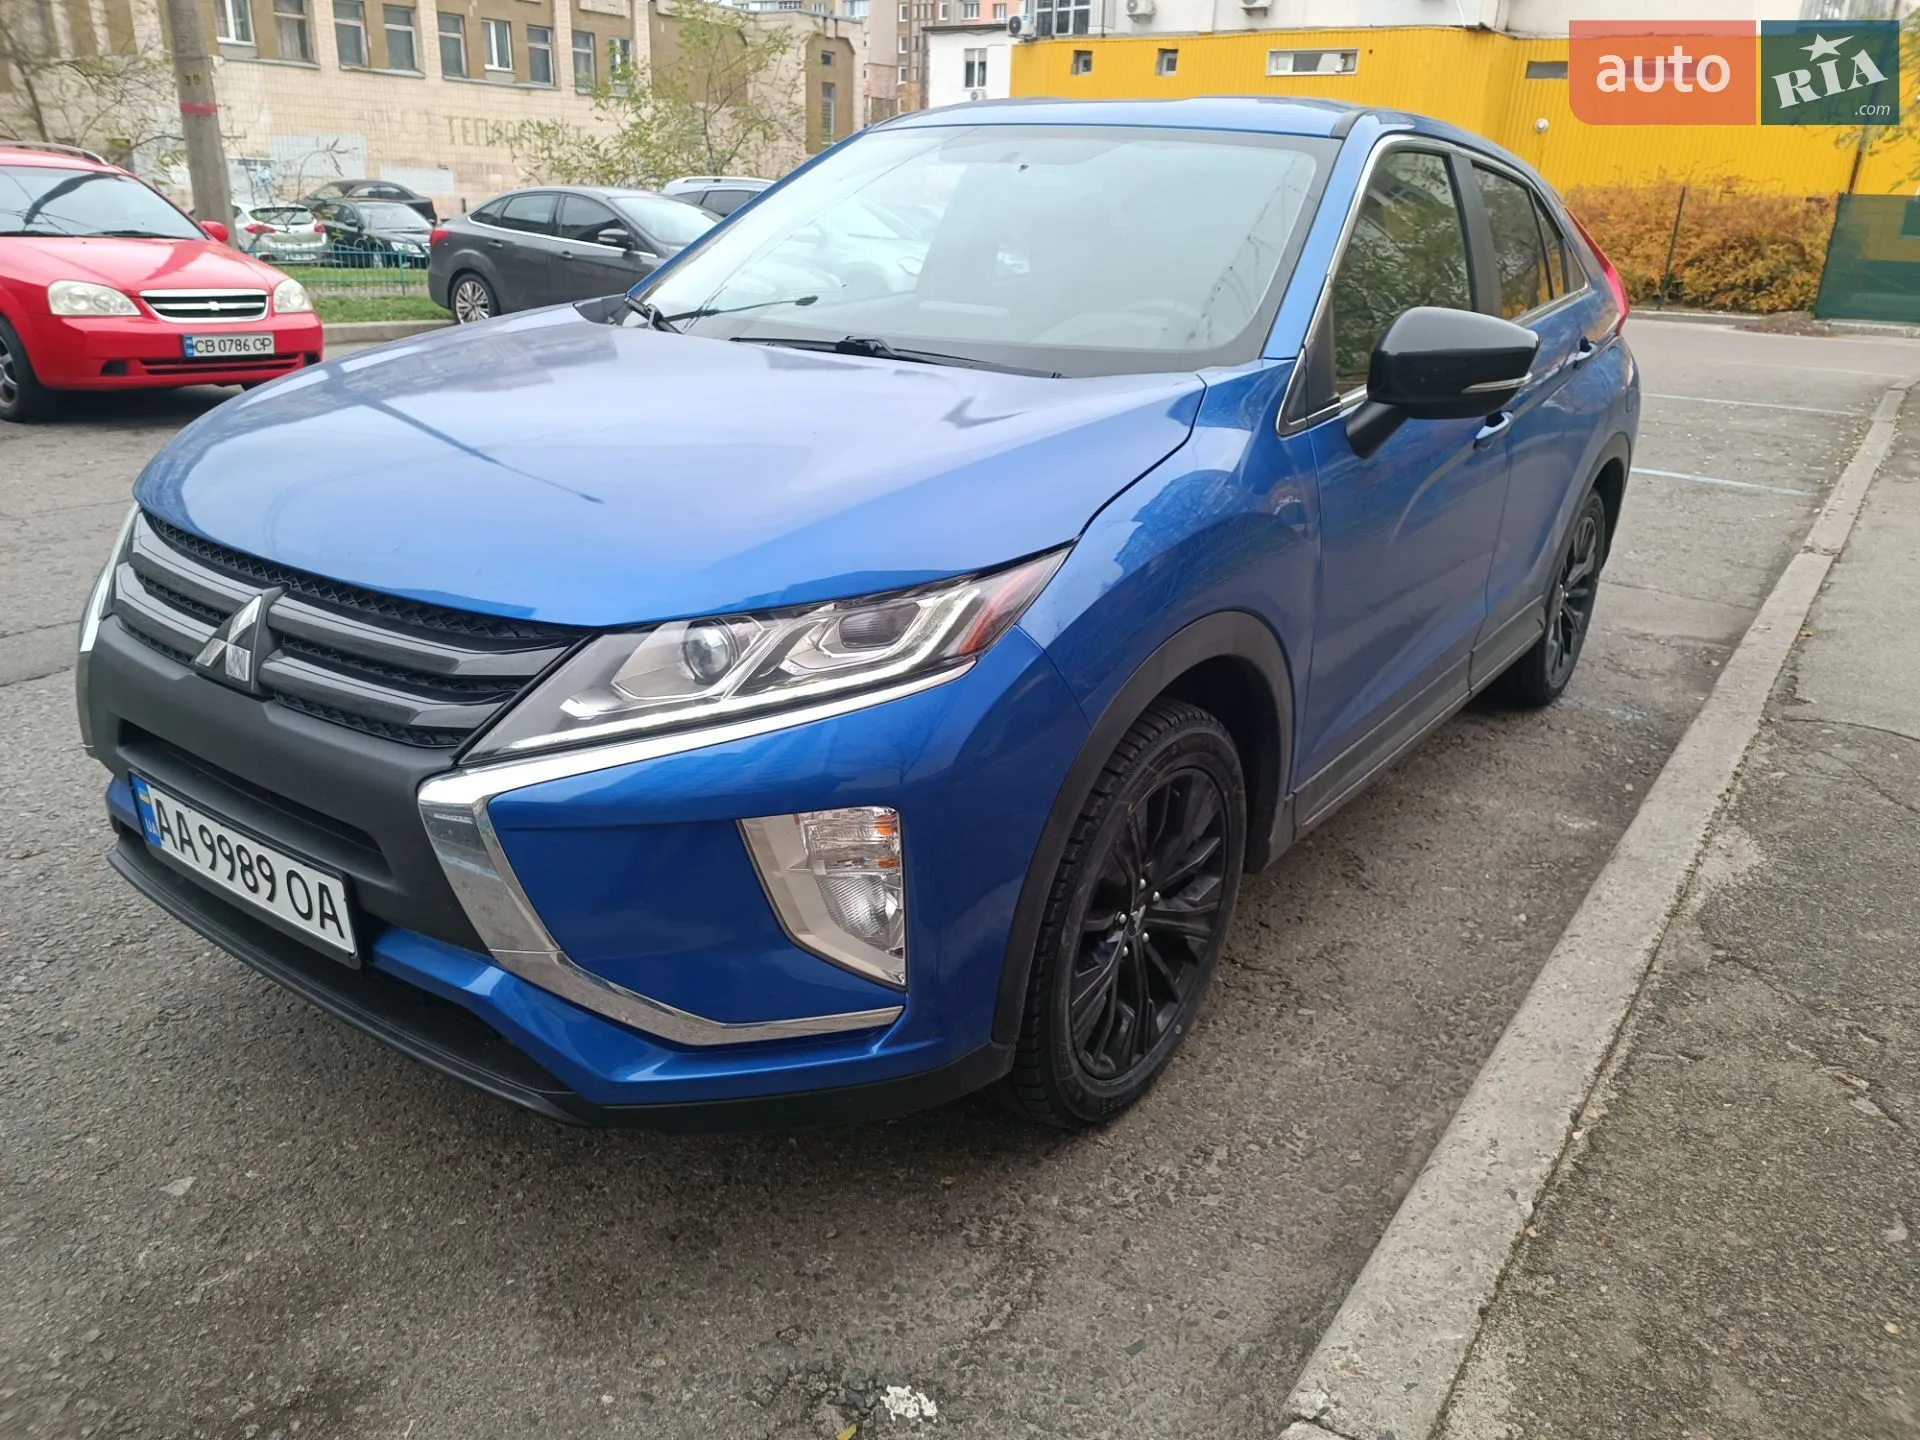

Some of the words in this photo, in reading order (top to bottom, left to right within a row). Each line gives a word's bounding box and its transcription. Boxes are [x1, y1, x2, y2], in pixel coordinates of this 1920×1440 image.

[194, 339, 216, 354] CB
[217, 338, 251, 353] 0786
[252, 337, 272, 352] CP
[145, 817, 158, 837] UA
[155, 797, 201, 863] AA
[198, 823, 277, 904] 9989
[286, 868, 346, 940] OA
